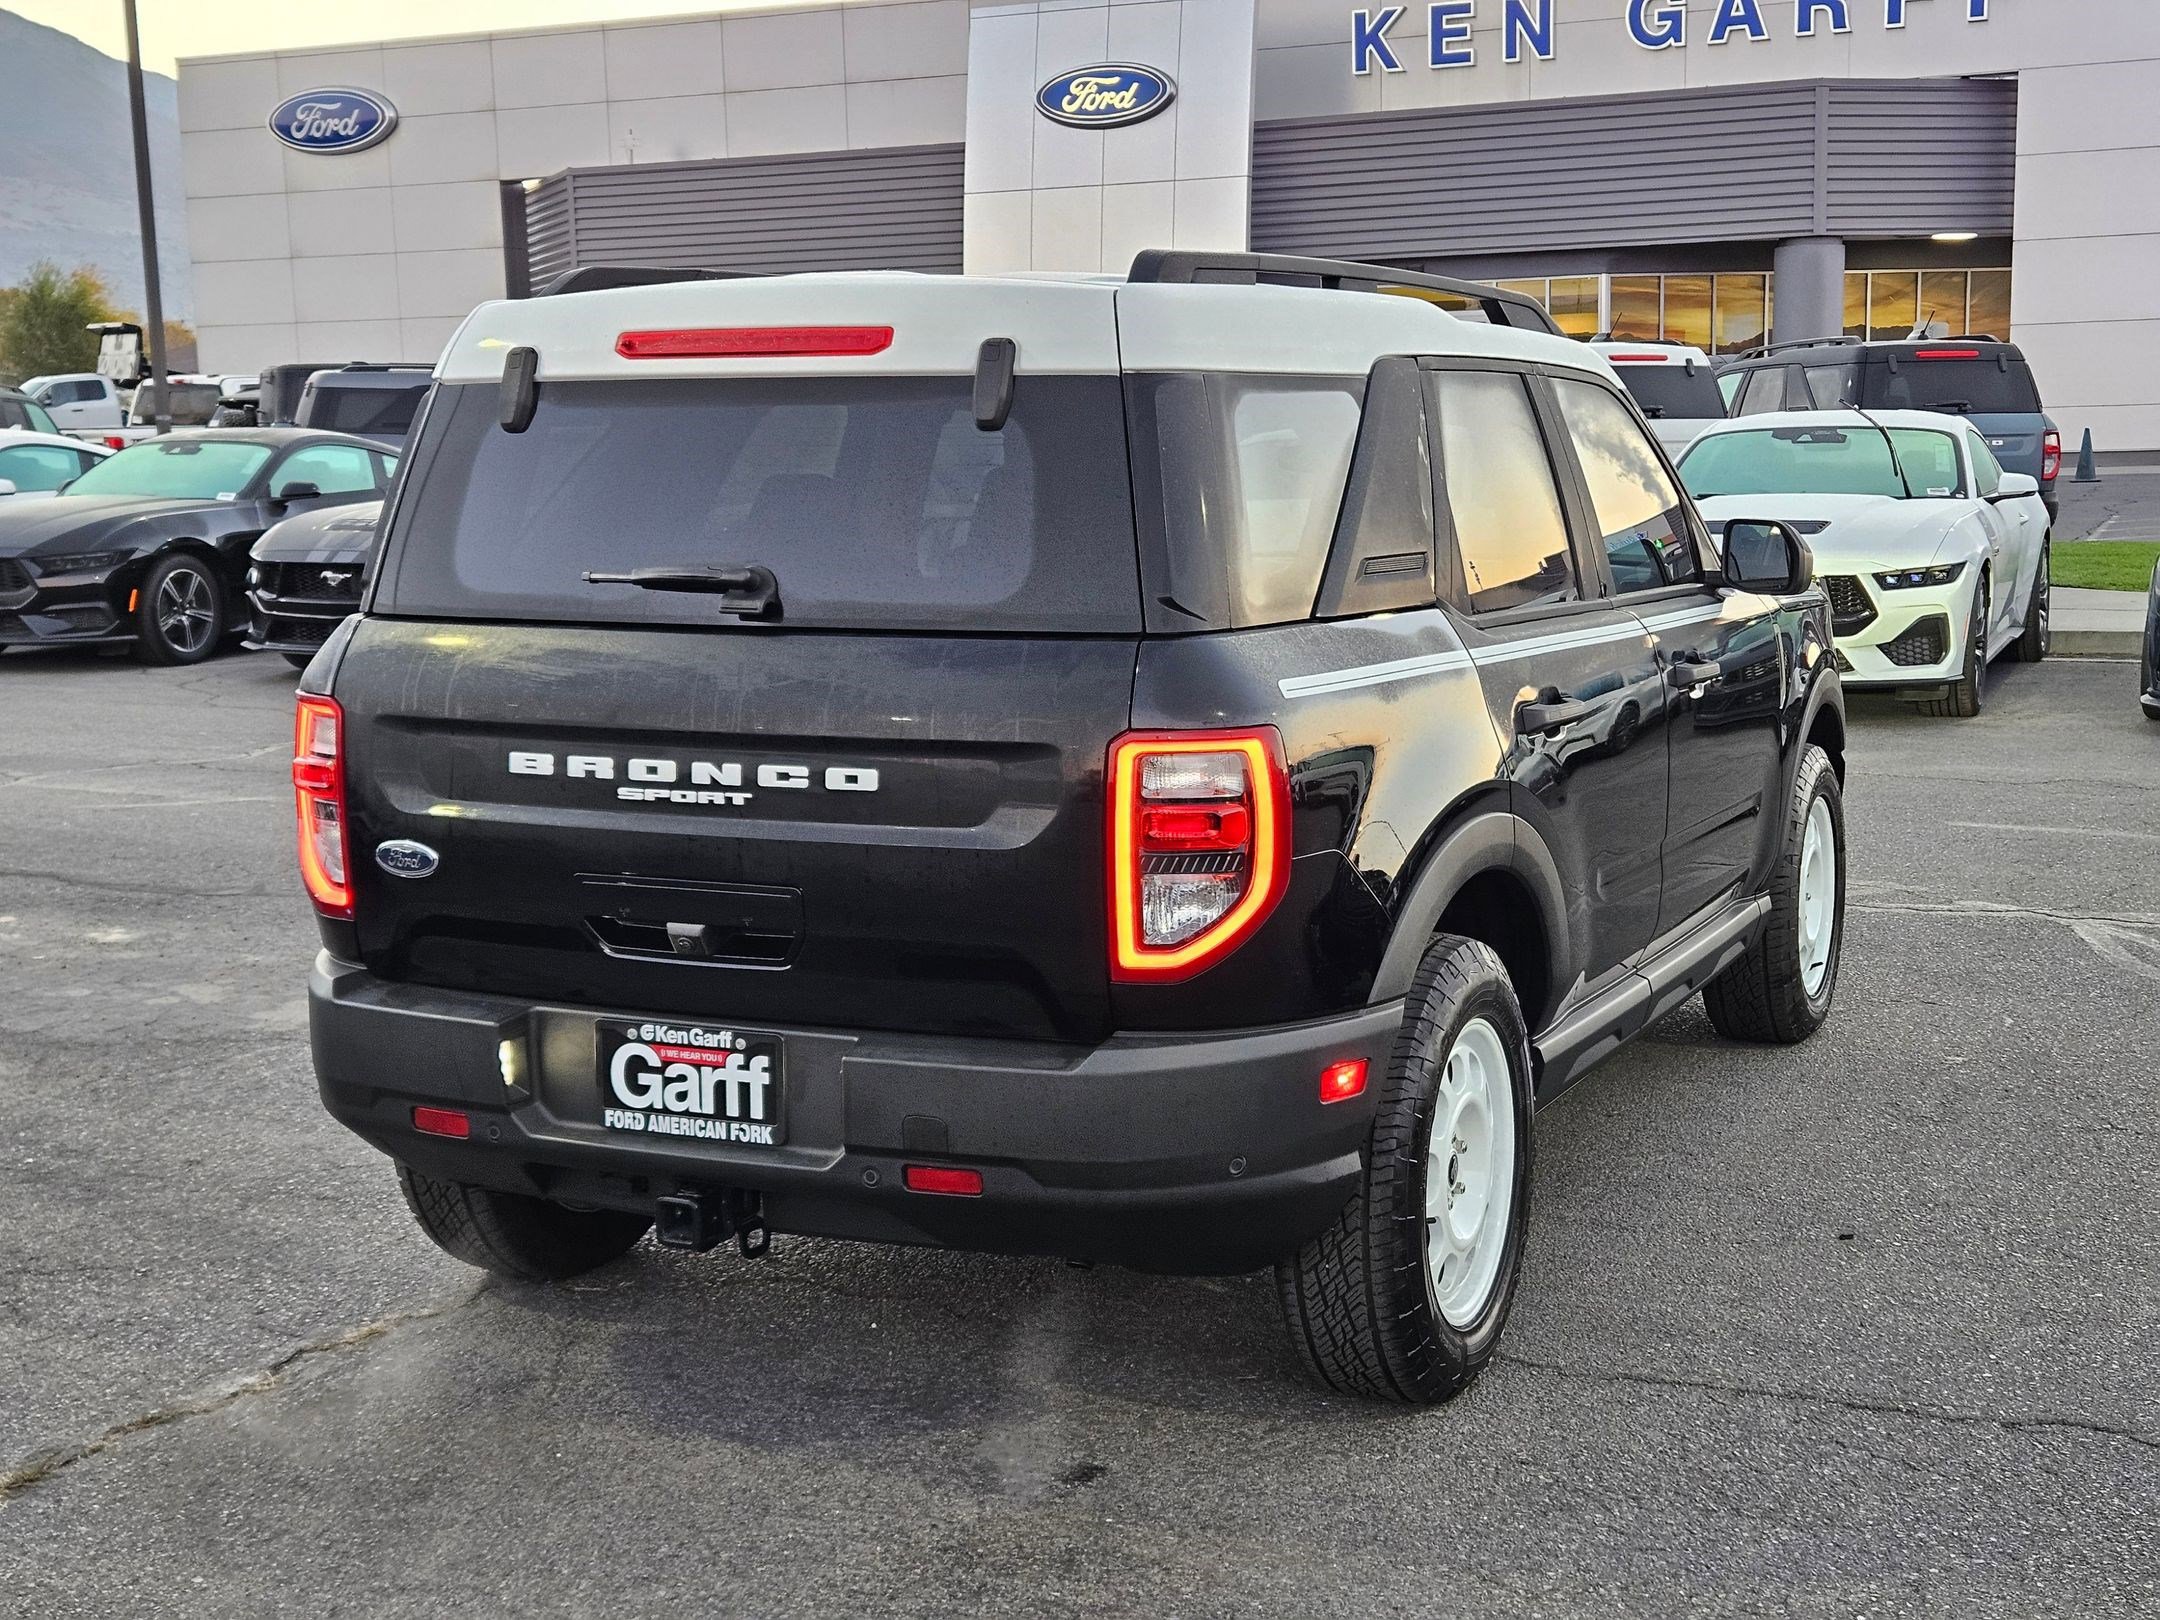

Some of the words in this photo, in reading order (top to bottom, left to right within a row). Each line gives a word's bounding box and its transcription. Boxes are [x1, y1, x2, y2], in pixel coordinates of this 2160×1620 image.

[1352, 0, 1555, 75] KEN
[1061, 76, 1139, 113] Ford
[290, 102, 360, 139] Ford
[508, 751, 879, 792] BRONCO
[617, 787, 753, 806] SPORT
[388, 847, 421, 868] Ford
[656, 1026, 688, 1044] Ken
[689, 1028, 732, 1048] Garff
[666, 1049, 679, 1058] WE
[680, 1051, 701, 1061] HEAR
[702, 1053, 717, 1062] YOU
[610, 1042, 770, 1120] Garff
[604, 1109, 645, 1131] FORD
[648, 1114, 727, 1140] AMERICAN
[730, 1123, 773, 1145] FORK
